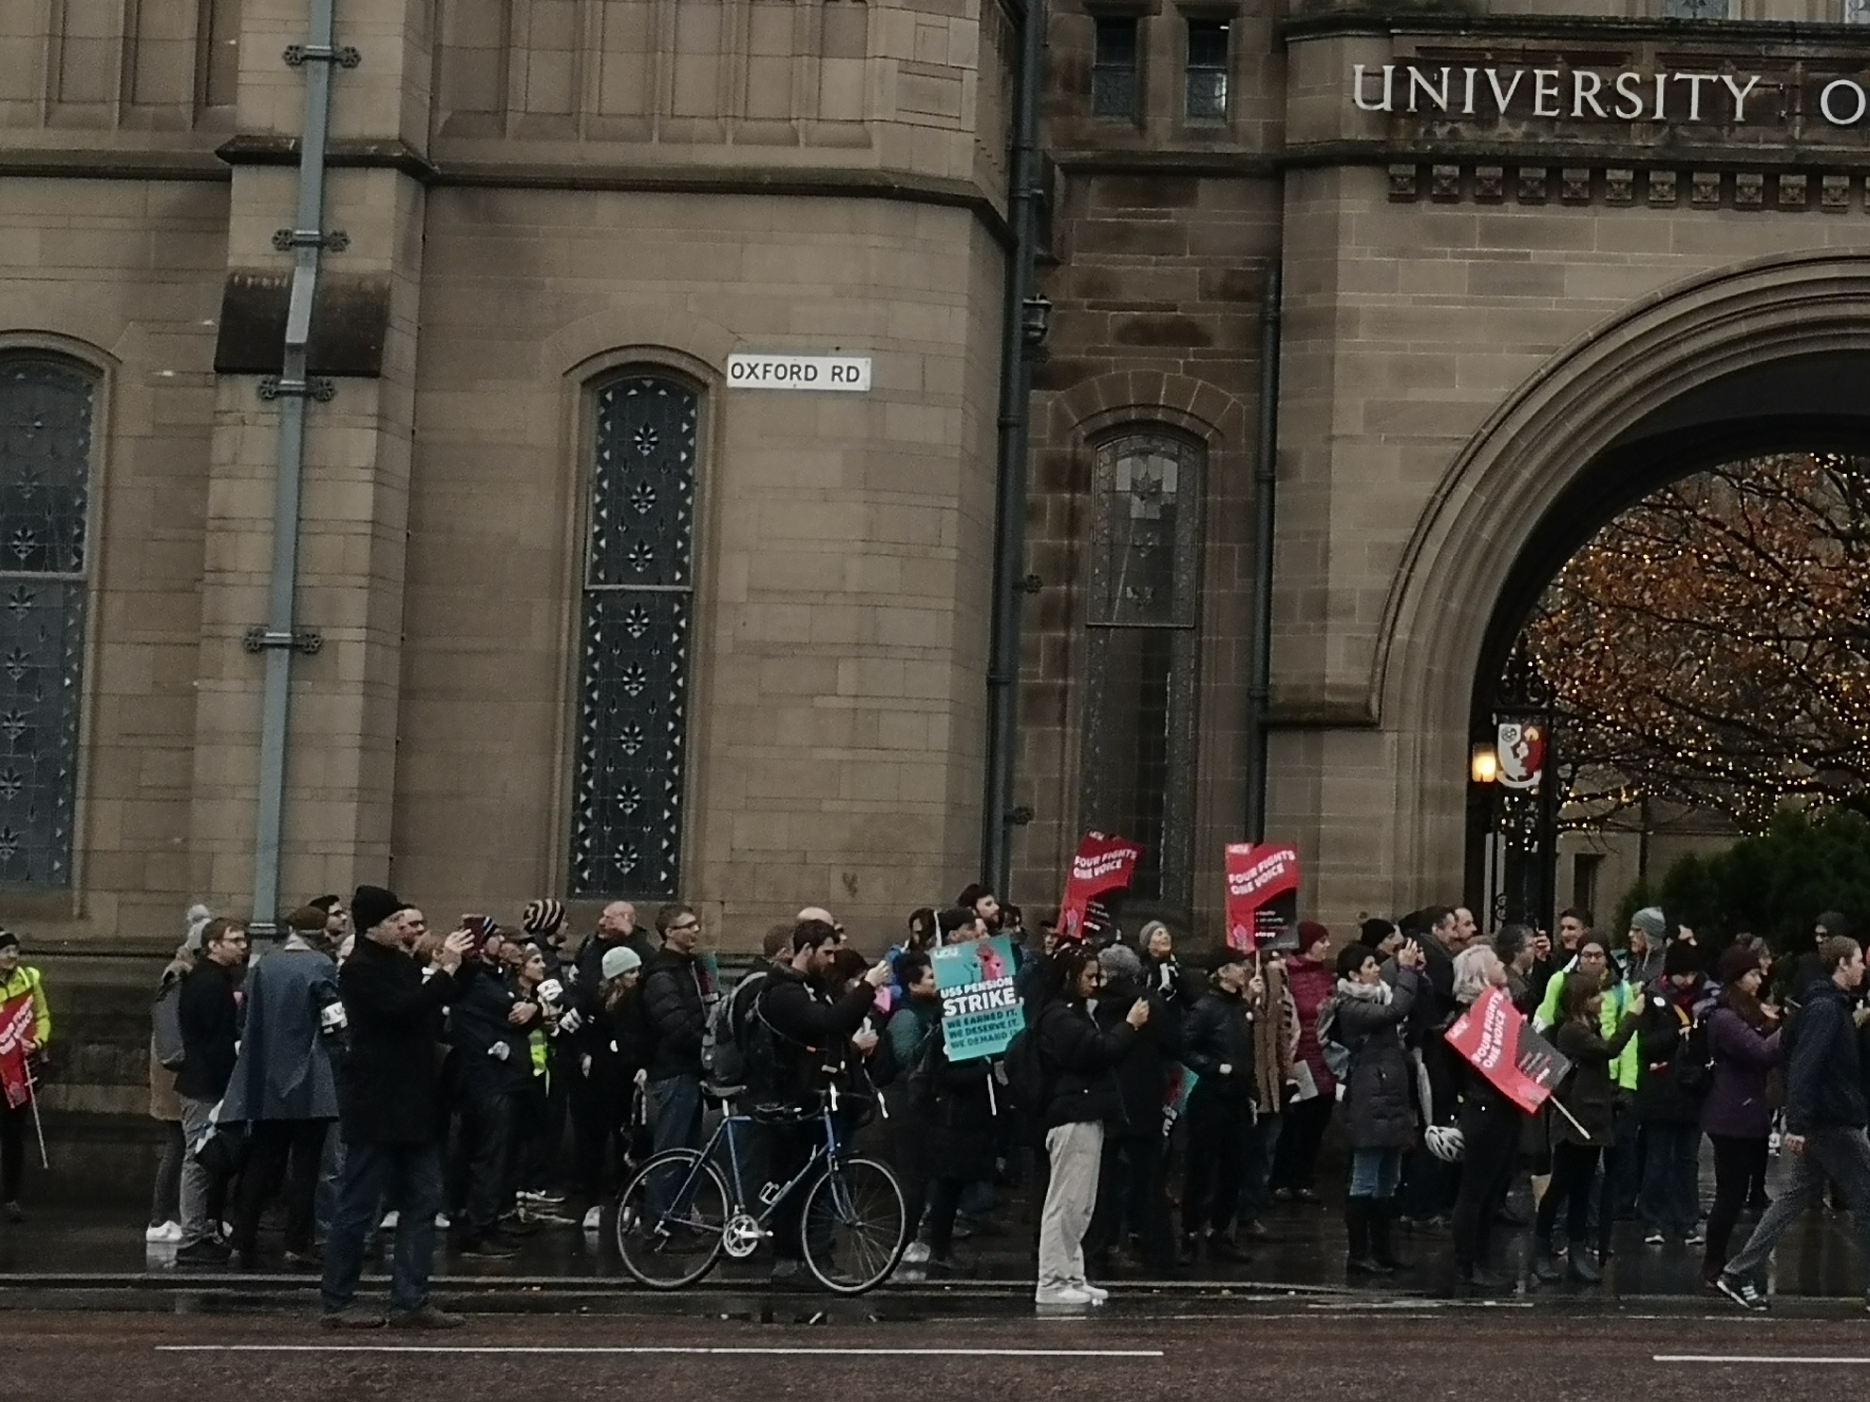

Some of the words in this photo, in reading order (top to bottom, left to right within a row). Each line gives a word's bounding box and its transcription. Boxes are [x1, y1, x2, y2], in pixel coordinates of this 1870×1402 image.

[1353, 63, 1762, 122] UNIVERSITY
[730, 362, 818, 382] OXFORD
[831, 365, 860, 383] RD
[1073, 867, 1093, 879] ONE
[1094, 858, 1123, 877] VOICE
[1074, 855, 1101, 868] FOUR
[1102, 848, 1138, 862] FIGHTS
[1228, 867, 1258, 884] FOUR
[1257, 850, 1296, 873] FIGHTS
[1230, 880, 1255, 896] ONE
[1254, 862, 1285, 888] VOICE
[940, 985, 963, 999] USS
[964, 976, 1014, 994] PENSION
[942, 986, 1017, 1017] STRIKE
[947, 1018, 962, 1029] WE
[964, 1010, 1004, 1026] EARNED
[965, 1020, 1006, 1035] DESERVE
[1472, 1031, 1493, 1063] FOUR
[1484, 991, 1504, 1031] FIGHTS
[951, 1040, 965, 1049] WE
[967, 1032, 1008, 1046] DEMAND
[1482, 1045, 1502, 1069] ONE
[1492, 1009, 1507, 1046] VOICE
